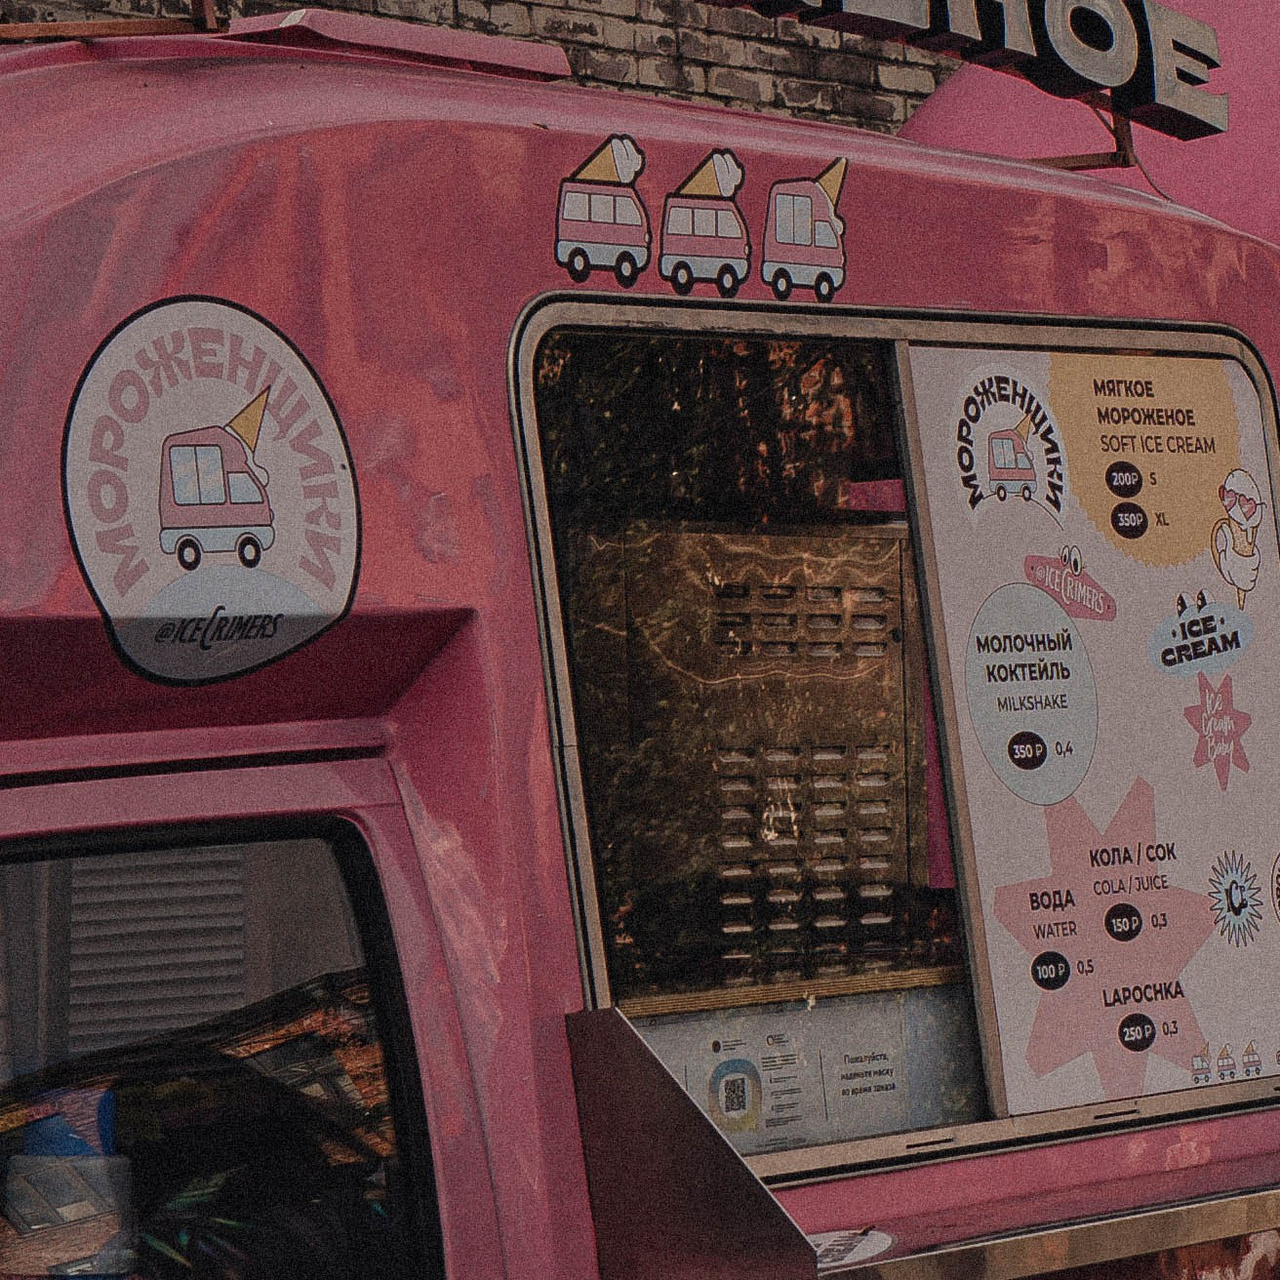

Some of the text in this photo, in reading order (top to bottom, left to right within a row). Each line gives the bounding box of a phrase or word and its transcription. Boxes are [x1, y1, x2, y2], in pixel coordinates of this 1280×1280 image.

[1093, 378, 1155, 398] МЯГКОЕ
[1096, 406, 1196, 427] МОРОЖЕНОЕ
[956, 375, 1067, 512] МОРОЖЕНЩИКИ
[1100, 434, 1216, 454] SOFT ICE CREAM
[87, 326, 345, 599] МОРОЖЕНЩИКИ
[1149, 472, 1157, 486] S
[1155, 512, 1170, 527] XL
[1180, 613, 1217, 640] ICE
[975, 627, 1073, 655] МОЛОЧНЫЙ
[1160, 628, 1242, 668] CREAM
[985, 659, 1071, 683] КОКТЕЙЛЬ
[996, 693, 1069, 713] MILKSHAKE
[1055, 741, 1074, 758] 0,4
[1089, 847, 1133, 868] КОЛА
[1145, 842, 1177, 862] СОК
[1093, 878, 1127, 895] COLA
[1135, 874, 1169, 892] JUICE
[1029, 889, 1076, 912] ВОДА
[1225, 879, 1248, 916] ICE
[1032, 920, 1078, 940] WATER
[1151, 913, 1168, 930] 0,3
[1076, 960, 1094, 976] 0,5
[1102, 980, 1185, 1008] LAPOCHKA
[1162, 1020, 1179, 1038] 0,3
